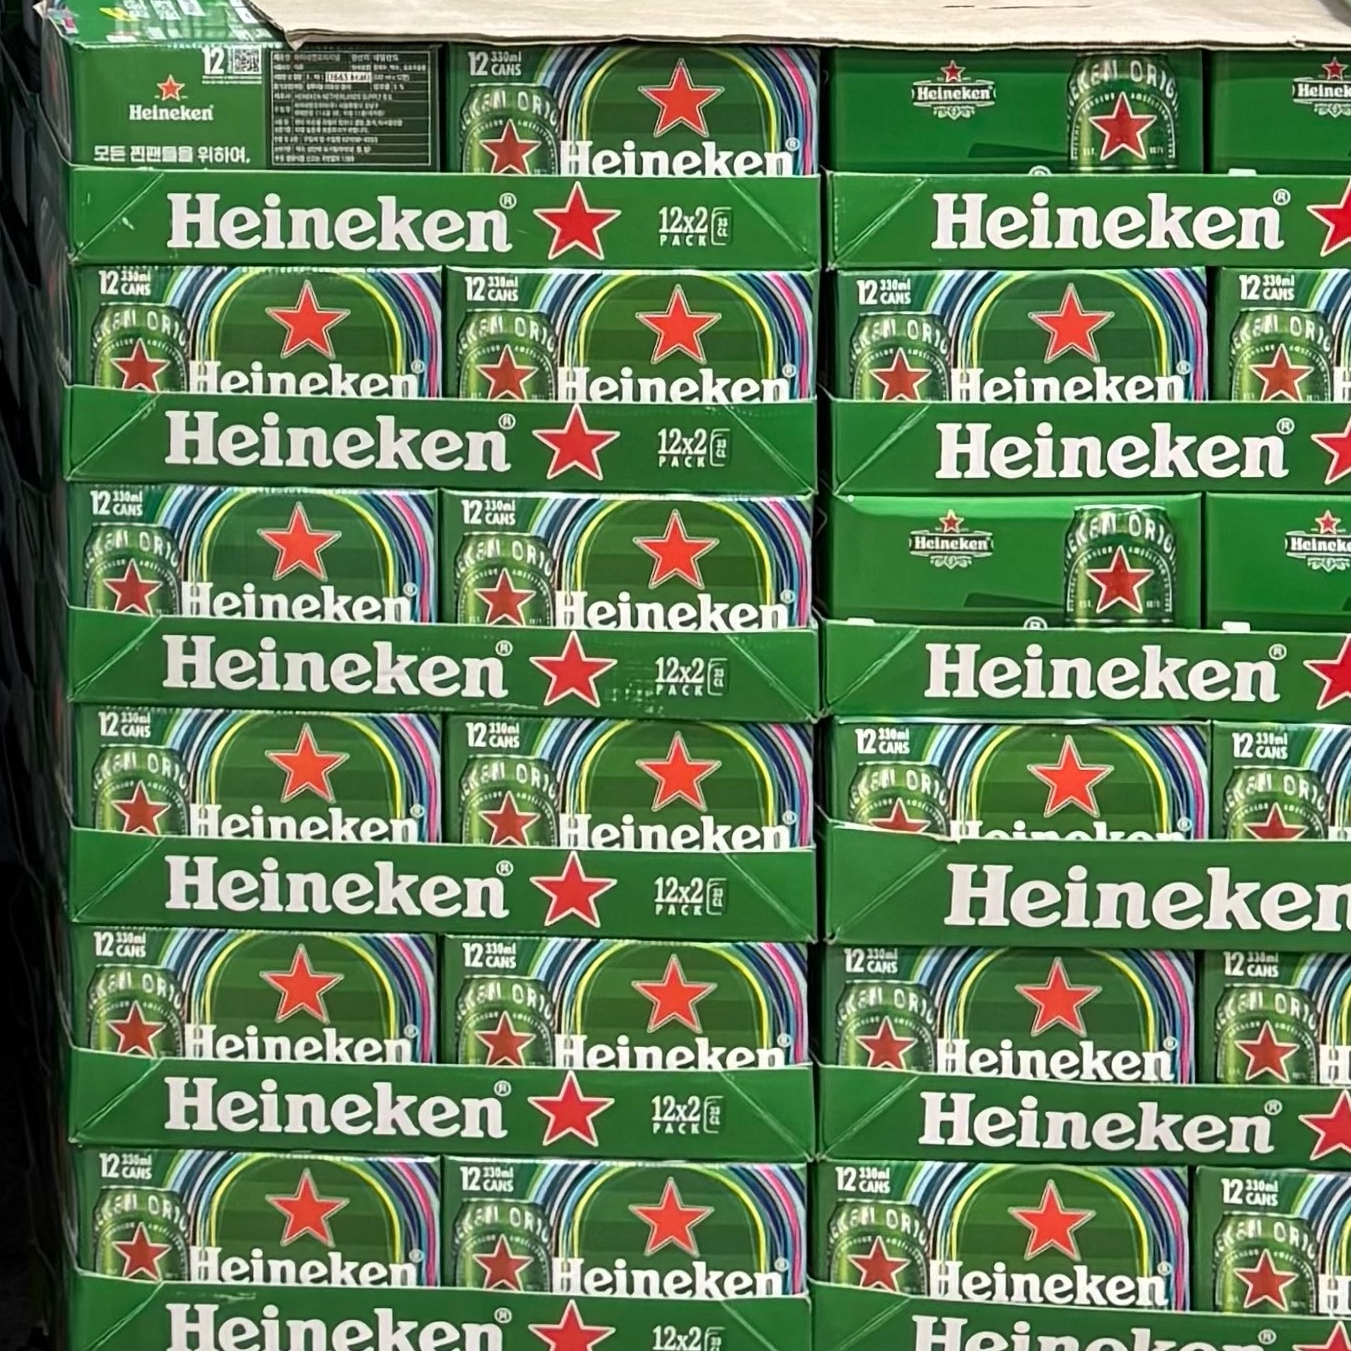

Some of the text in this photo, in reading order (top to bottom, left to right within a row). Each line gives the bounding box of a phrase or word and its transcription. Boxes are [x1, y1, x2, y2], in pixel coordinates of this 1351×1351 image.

[202, 46, 225, 75] 12
[468, 51, 488, 76] 12
[490, 63, 521, 76] CANS
[916, 86, 991, 101] Heineken
[129, 104, 213, 121] Heineken
[94, 145, 126, 164] 모든
[560, 140, 794, 177] Heineken
[167, 193, 512, 253] Heineken
[658, 206, 708, 234] 12x2
[930, 191, 1285, 250] Heineken
[856, 280, 877, 303] 12
[879, 280, 911, 291] 330ml
[879, 291, 911, 304] CANS
[557, 366, 790, 401] Heineken
[950, 366, 1184, 402] Heineken
[164, 410, 511, 472] Heineken
[657, 429, 707, 454] 12x2
[935, 421, 1289, 480] Heineken
[914, 536, 989, 550] Heineken
[181, 581, 413, 623] Heineken
[555, 590, 789, 631] Heineken
[162, 634, 508, 698] Heineken
[655, 657, 704, 683] 12x2
[924, 643, 1280, 702] Heineken
[1233, 733, 1253, 758] 12
[1255, 733, 1288, 745] 330ml
[1255, 746, 1288, 759] CANS
[559, 813, 790, 850] Heineken
[164, 855, 509, 919] Heineken
[654, 878, 703, 904] 12x2
[555, 1034, 784, 1070] Heineken
[936, 1038, 1175, 1083] Heineken
[164, 1077, 507, 1138] Heineken
[652, 1096, 701, 1122] 12x2
[918, 1092, 1275, 1154] Heineken
[189, 1246, 417, 1287] Heineken
[552, 1257, 784, 1298] Heineken
[929, 1259, 1169, 1307] Heineken
[653, 1326, 702, 1351] 12x2
